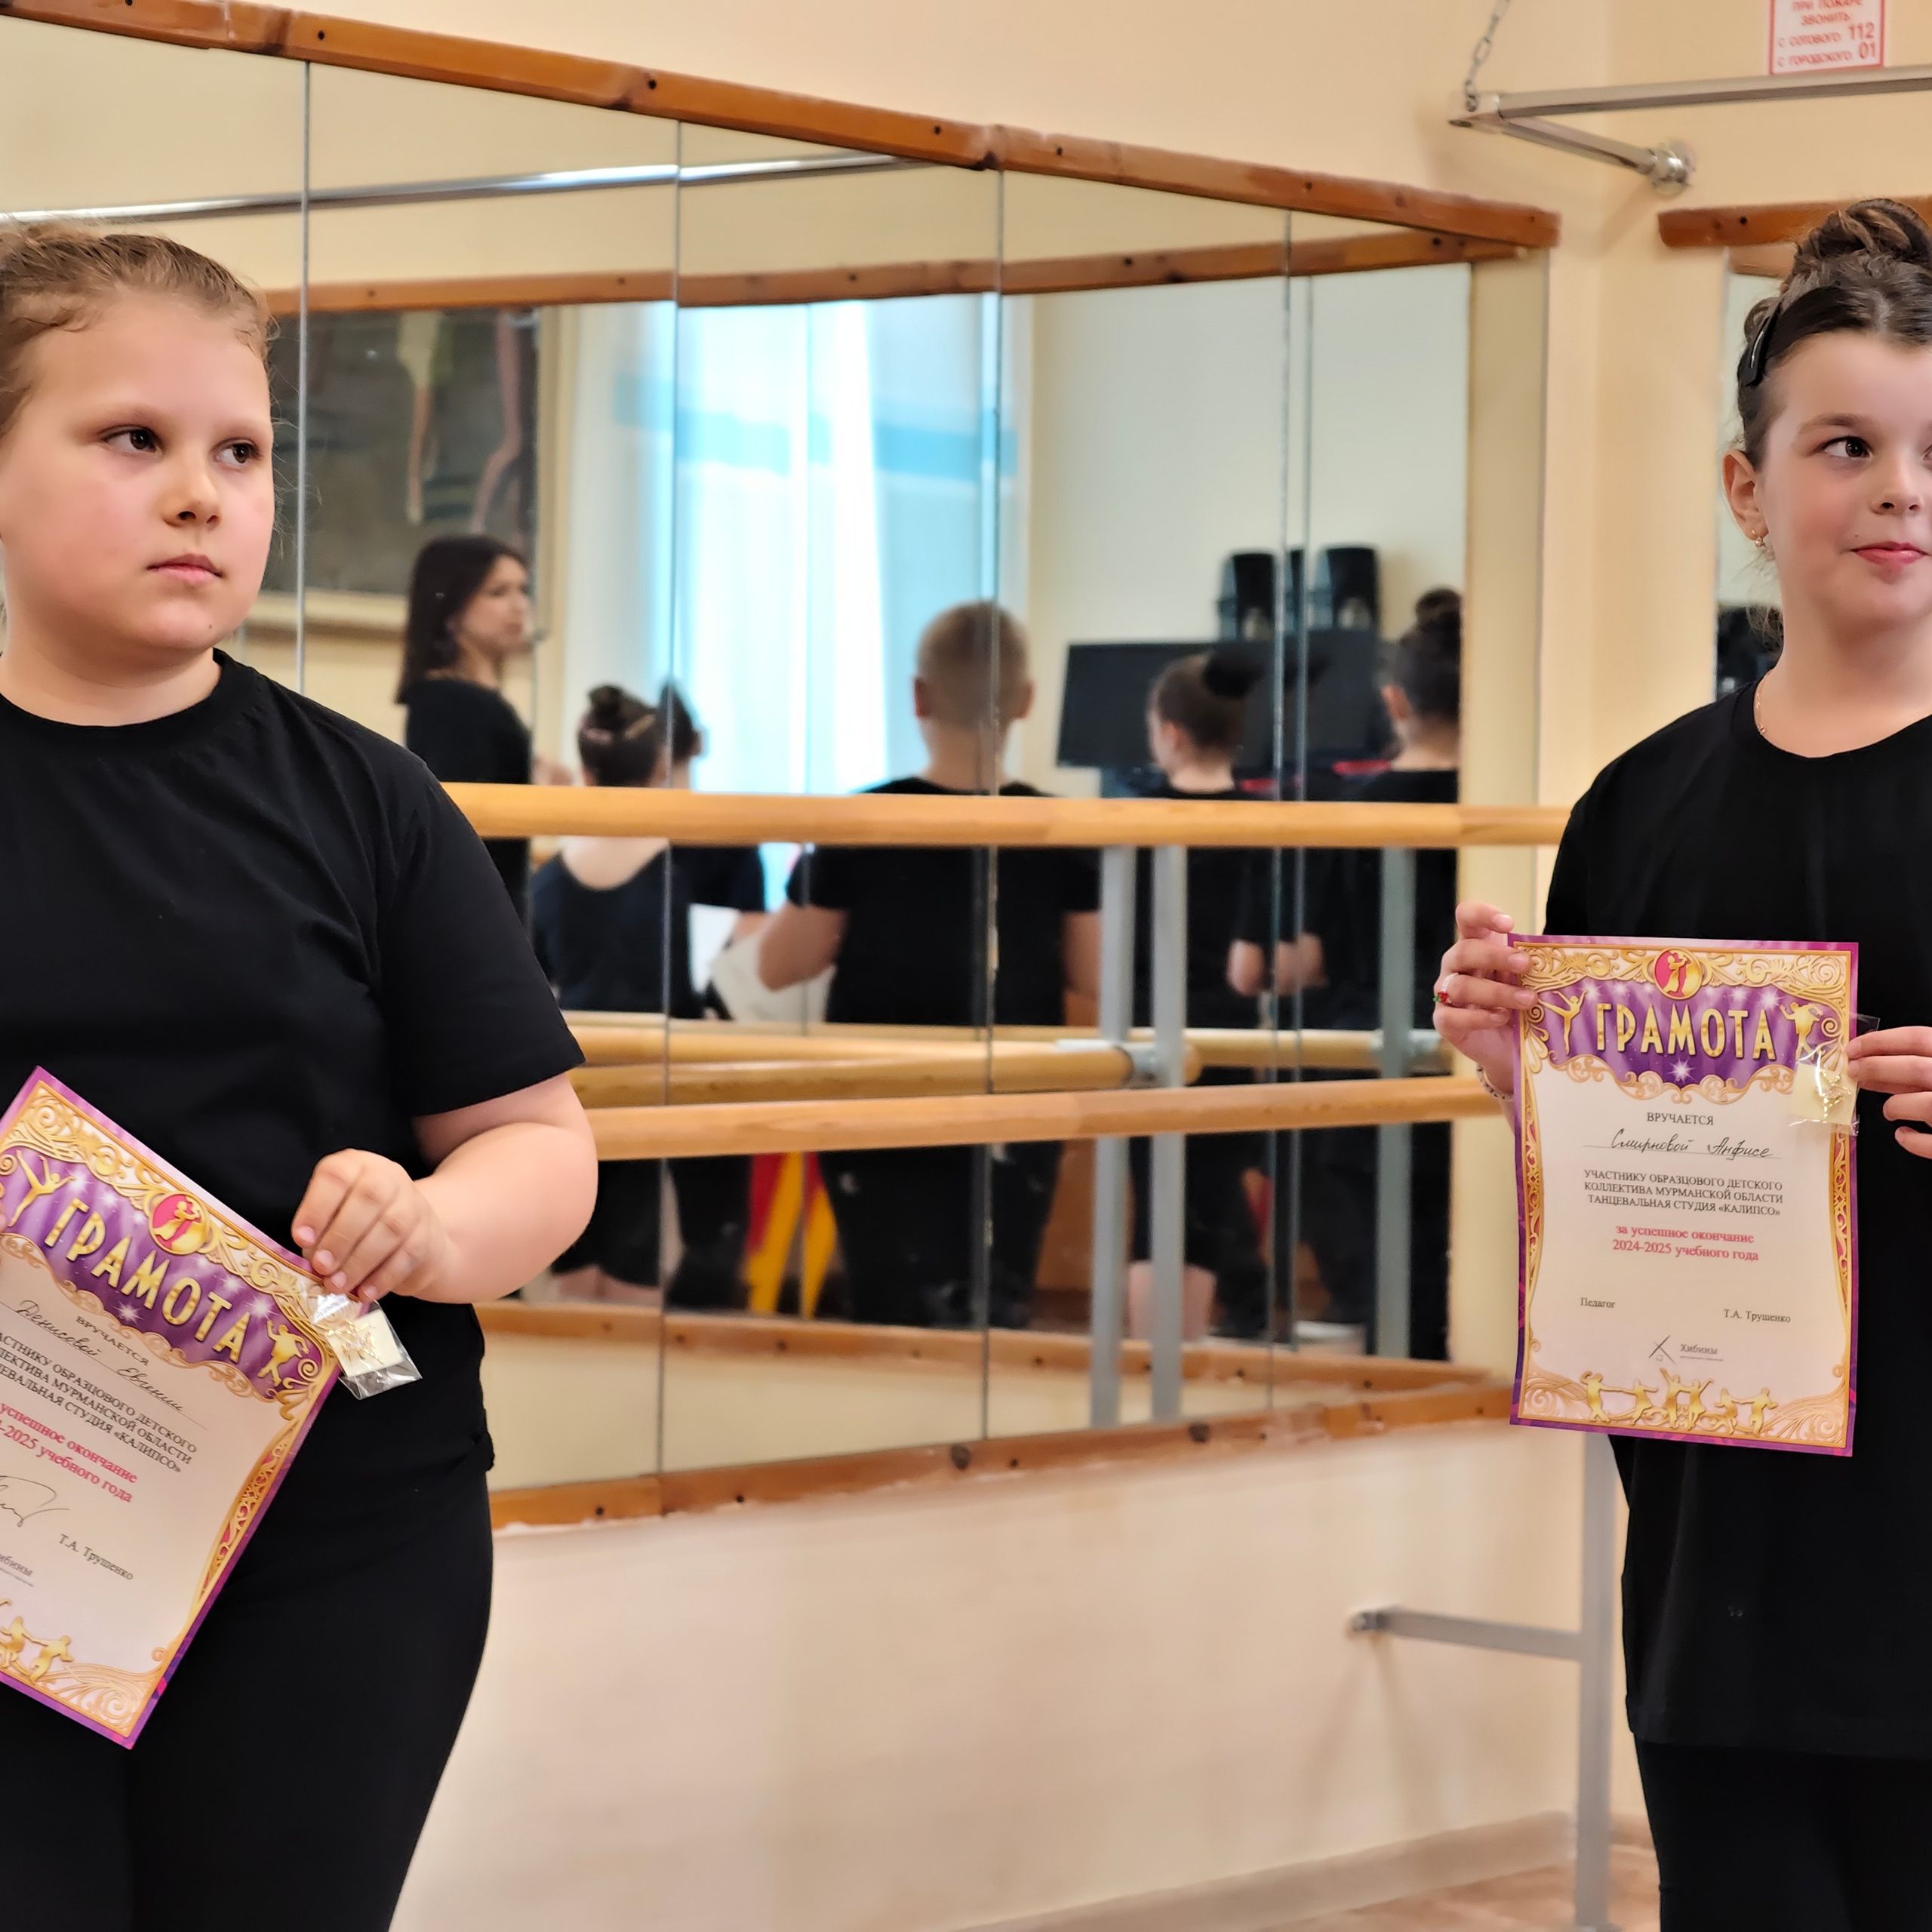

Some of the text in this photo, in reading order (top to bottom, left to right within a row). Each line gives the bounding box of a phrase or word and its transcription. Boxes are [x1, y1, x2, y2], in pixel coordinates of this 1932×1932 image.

[1849, 22, 1875, 40] 112
[1859, 42, 1876, 60] 01
[1595, 1002, 1776, 1060] ГРАМОТА
[1647, 1112, 1714, 1125] ВРУЧАЕТСЯ
[1611, 1128, 1774, 1161] Смирновой Анфисе
[1584, 1169, 1783, 1192] УЧАСТНИКУ ОБРАЗЦОВОГО ДЕТСКОГО
[1584, 1182, 1783, 1204] КОЛЛЕКТИВА МУРМАНСКОЙ ОБЛАСТИ
[1588, 1194, 1781, 1217] ТАНЦЕВАЛЬНАЯ СТУДИЯ «КАЛИПСО»
[1616, 1226, 1755, 1244] за успешное окончание
[1612, 1239, 1759, 1262] 2024-2025 учебного года
[43, 1197, 254, 1364] ГРАМОТА
[1580, 1297, 1616, 1309] Педагог
[1724, 1309, 1791, 1324] Т.А. Трушенко
[75, 1316, 149, 1367] ВРУЧАЕТСЯ
[1680, 1343, 1718, 1355] Хибины
[52, 1363, 136, 1417] ОБРАЗЦОВОГО
[136, 1412, 197, 1454] ДЕТСКОГО
[51, 1377, 137, 1432] МУРМАНСКОЙ
[137, 1426, 193, 1466] ОБЛАСТИ
[0, 1402, 138, 1484] успешное окончание
[64, 1401, 115, 1435] СТУДИЯ
[113, 1430, 182, 1473] «КАЛИПСО»
[35, 1445, 101, 1486] учебного
[101, 1479, 133, 1503] года
[59, 1534, 134, 1581] Т.А. Трушенко
